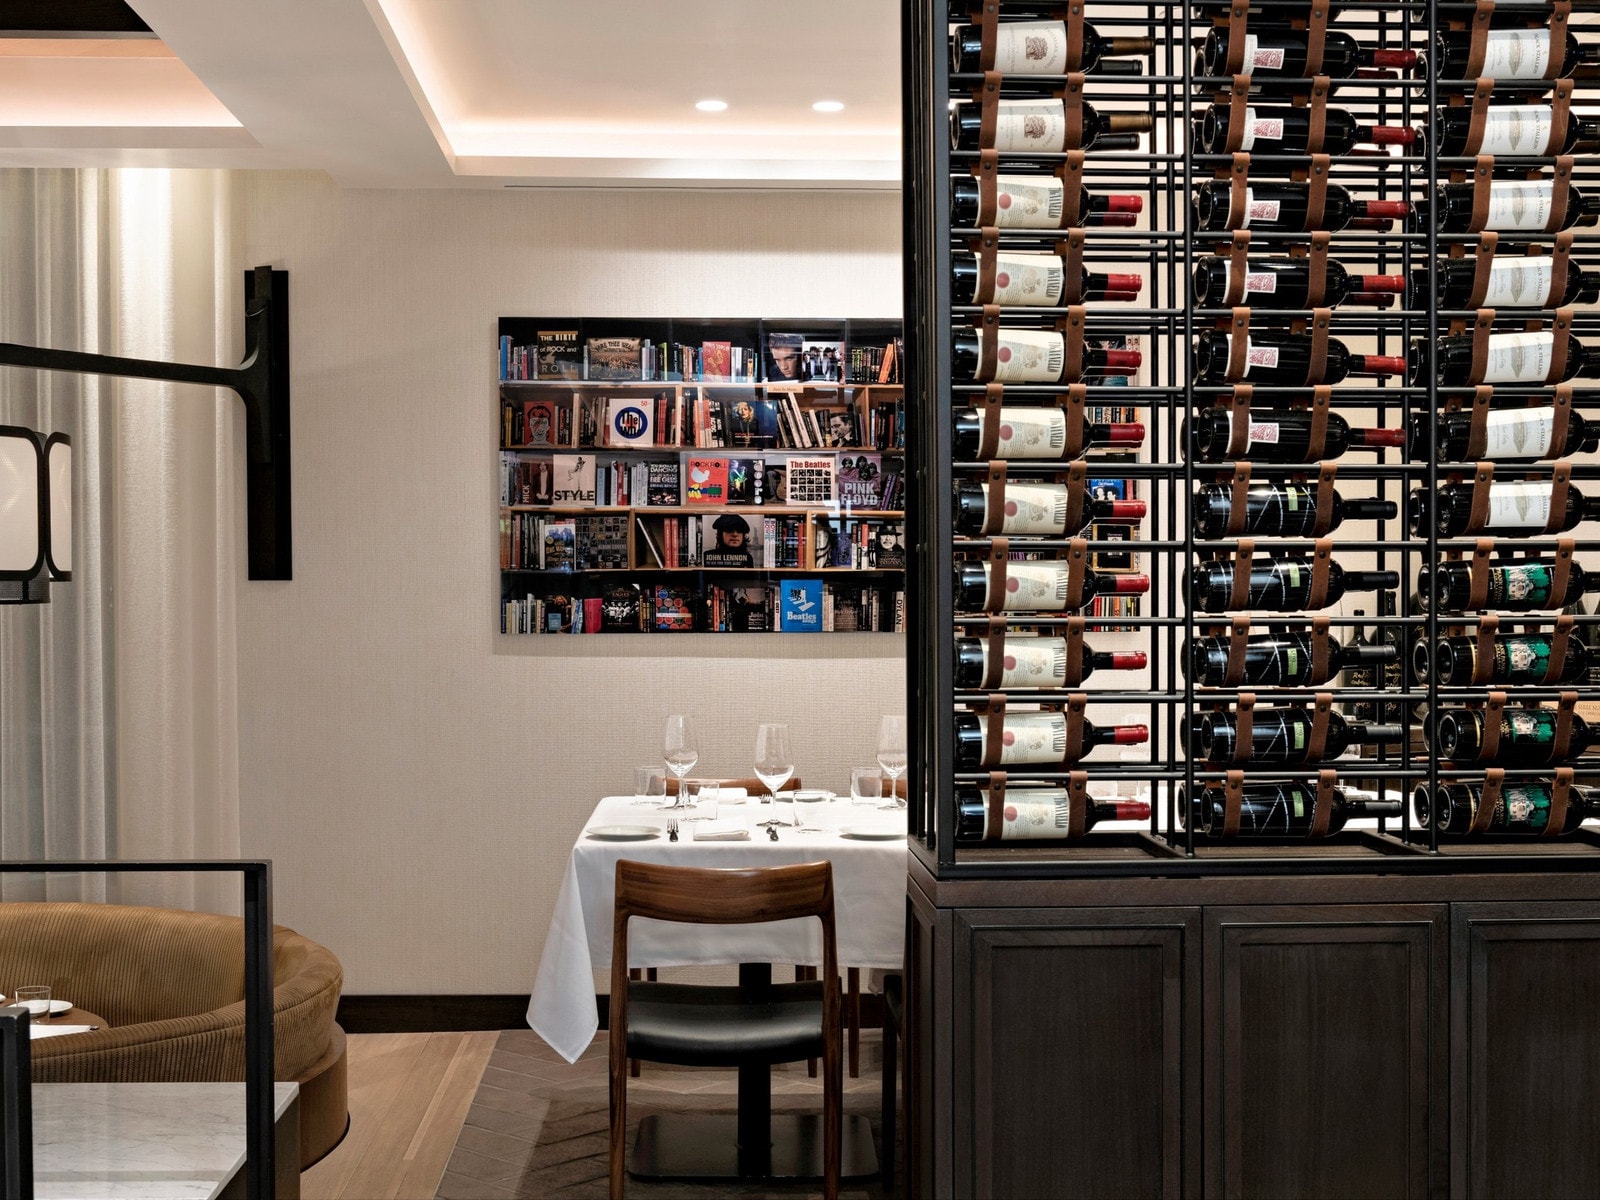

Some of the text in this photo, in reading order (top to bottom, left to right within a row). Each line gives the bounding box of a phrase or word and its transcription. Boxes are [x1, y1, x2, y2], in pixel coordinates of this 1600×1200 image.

[1533, 50, 1541, 74] STALLION
[1533, 125, 1541, 150] STALLION
[1048, 186, 1062, 218] TIGNANELLO
[1046, 267, 1061, 299] TIGNANELLO
[1048, 341, 1063, 373] TIGNANELLO
[1050, 417, 1063, 448] TIGNANELLO
[554, 490, 594, 500] STYLE
[841, 494, 878, 505] FLOYD
[845, 483, 874, 494] PINK
[1054, 494, 1067, 525] TIGNANELLO
[1056, 569, 1069, 600] TIGNANELLO
[787, 611, 816, 620] Beatles
[1053, 647, 1066, 678] TIGNANELLO
[1051, 721, 1064, 753] TIGNANELLO
[1054, 797, 1068, 829] TIGNANELLO
